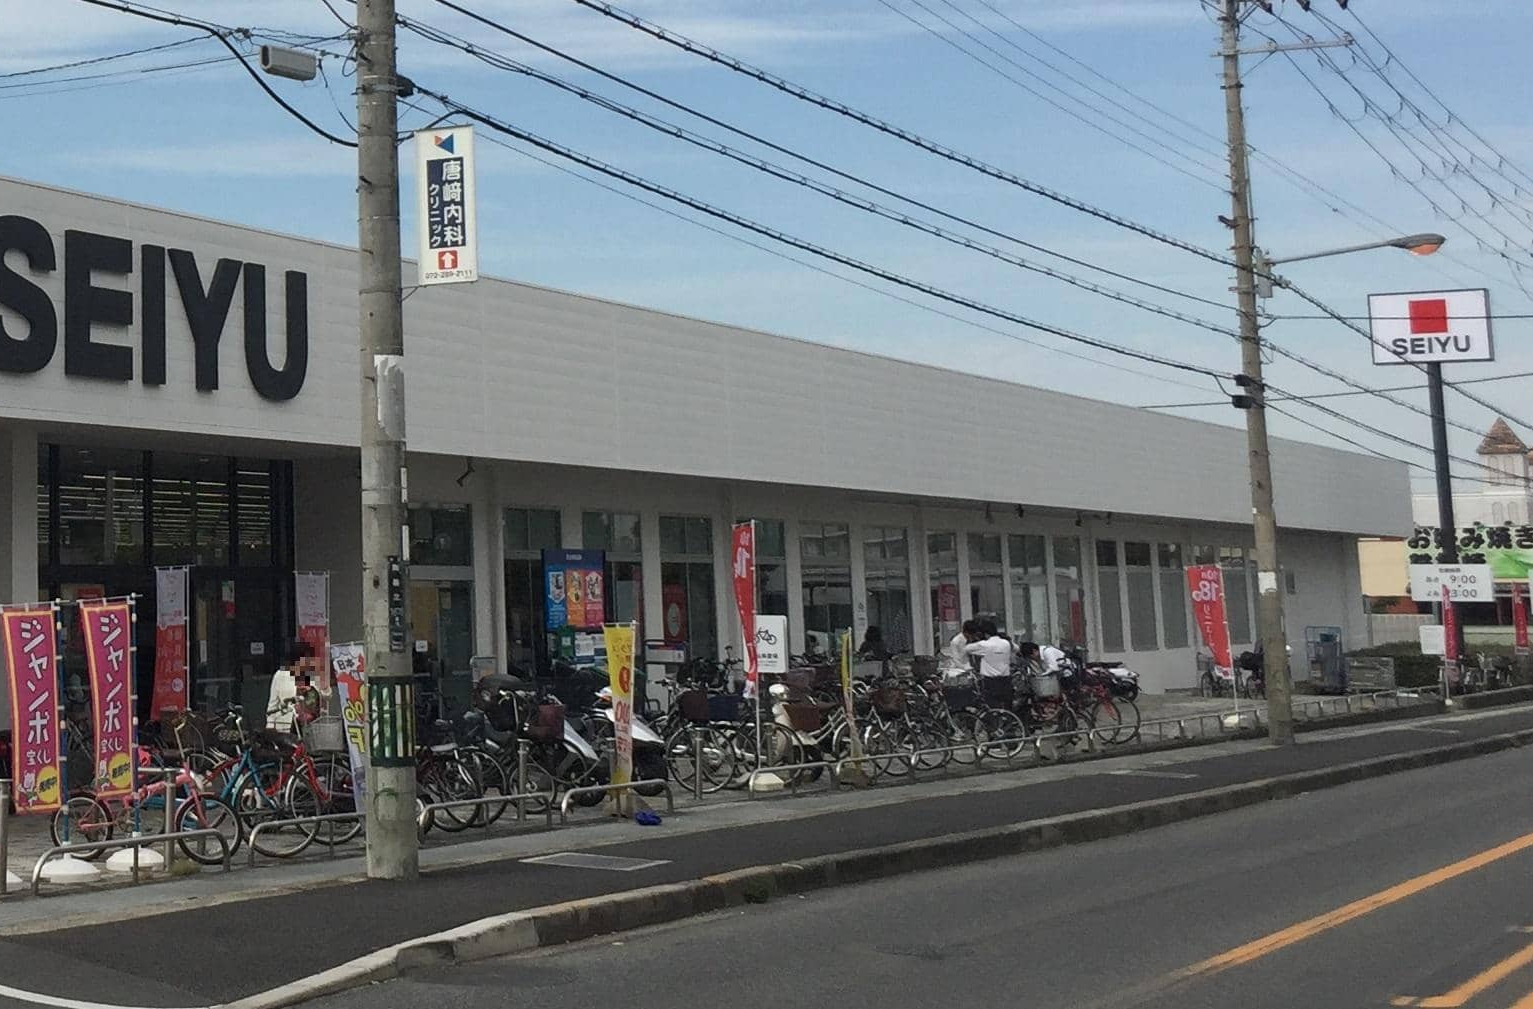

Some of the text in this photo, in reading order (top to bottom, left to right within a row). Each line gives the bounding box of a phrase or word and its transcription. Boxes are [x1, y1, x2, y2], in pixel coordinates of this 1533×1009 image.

[429, 183, 442, 247] クリニック
[1392, 335, 1471, 356] SEIYU
[1407, 526, 1533, 549] おみ焼き
